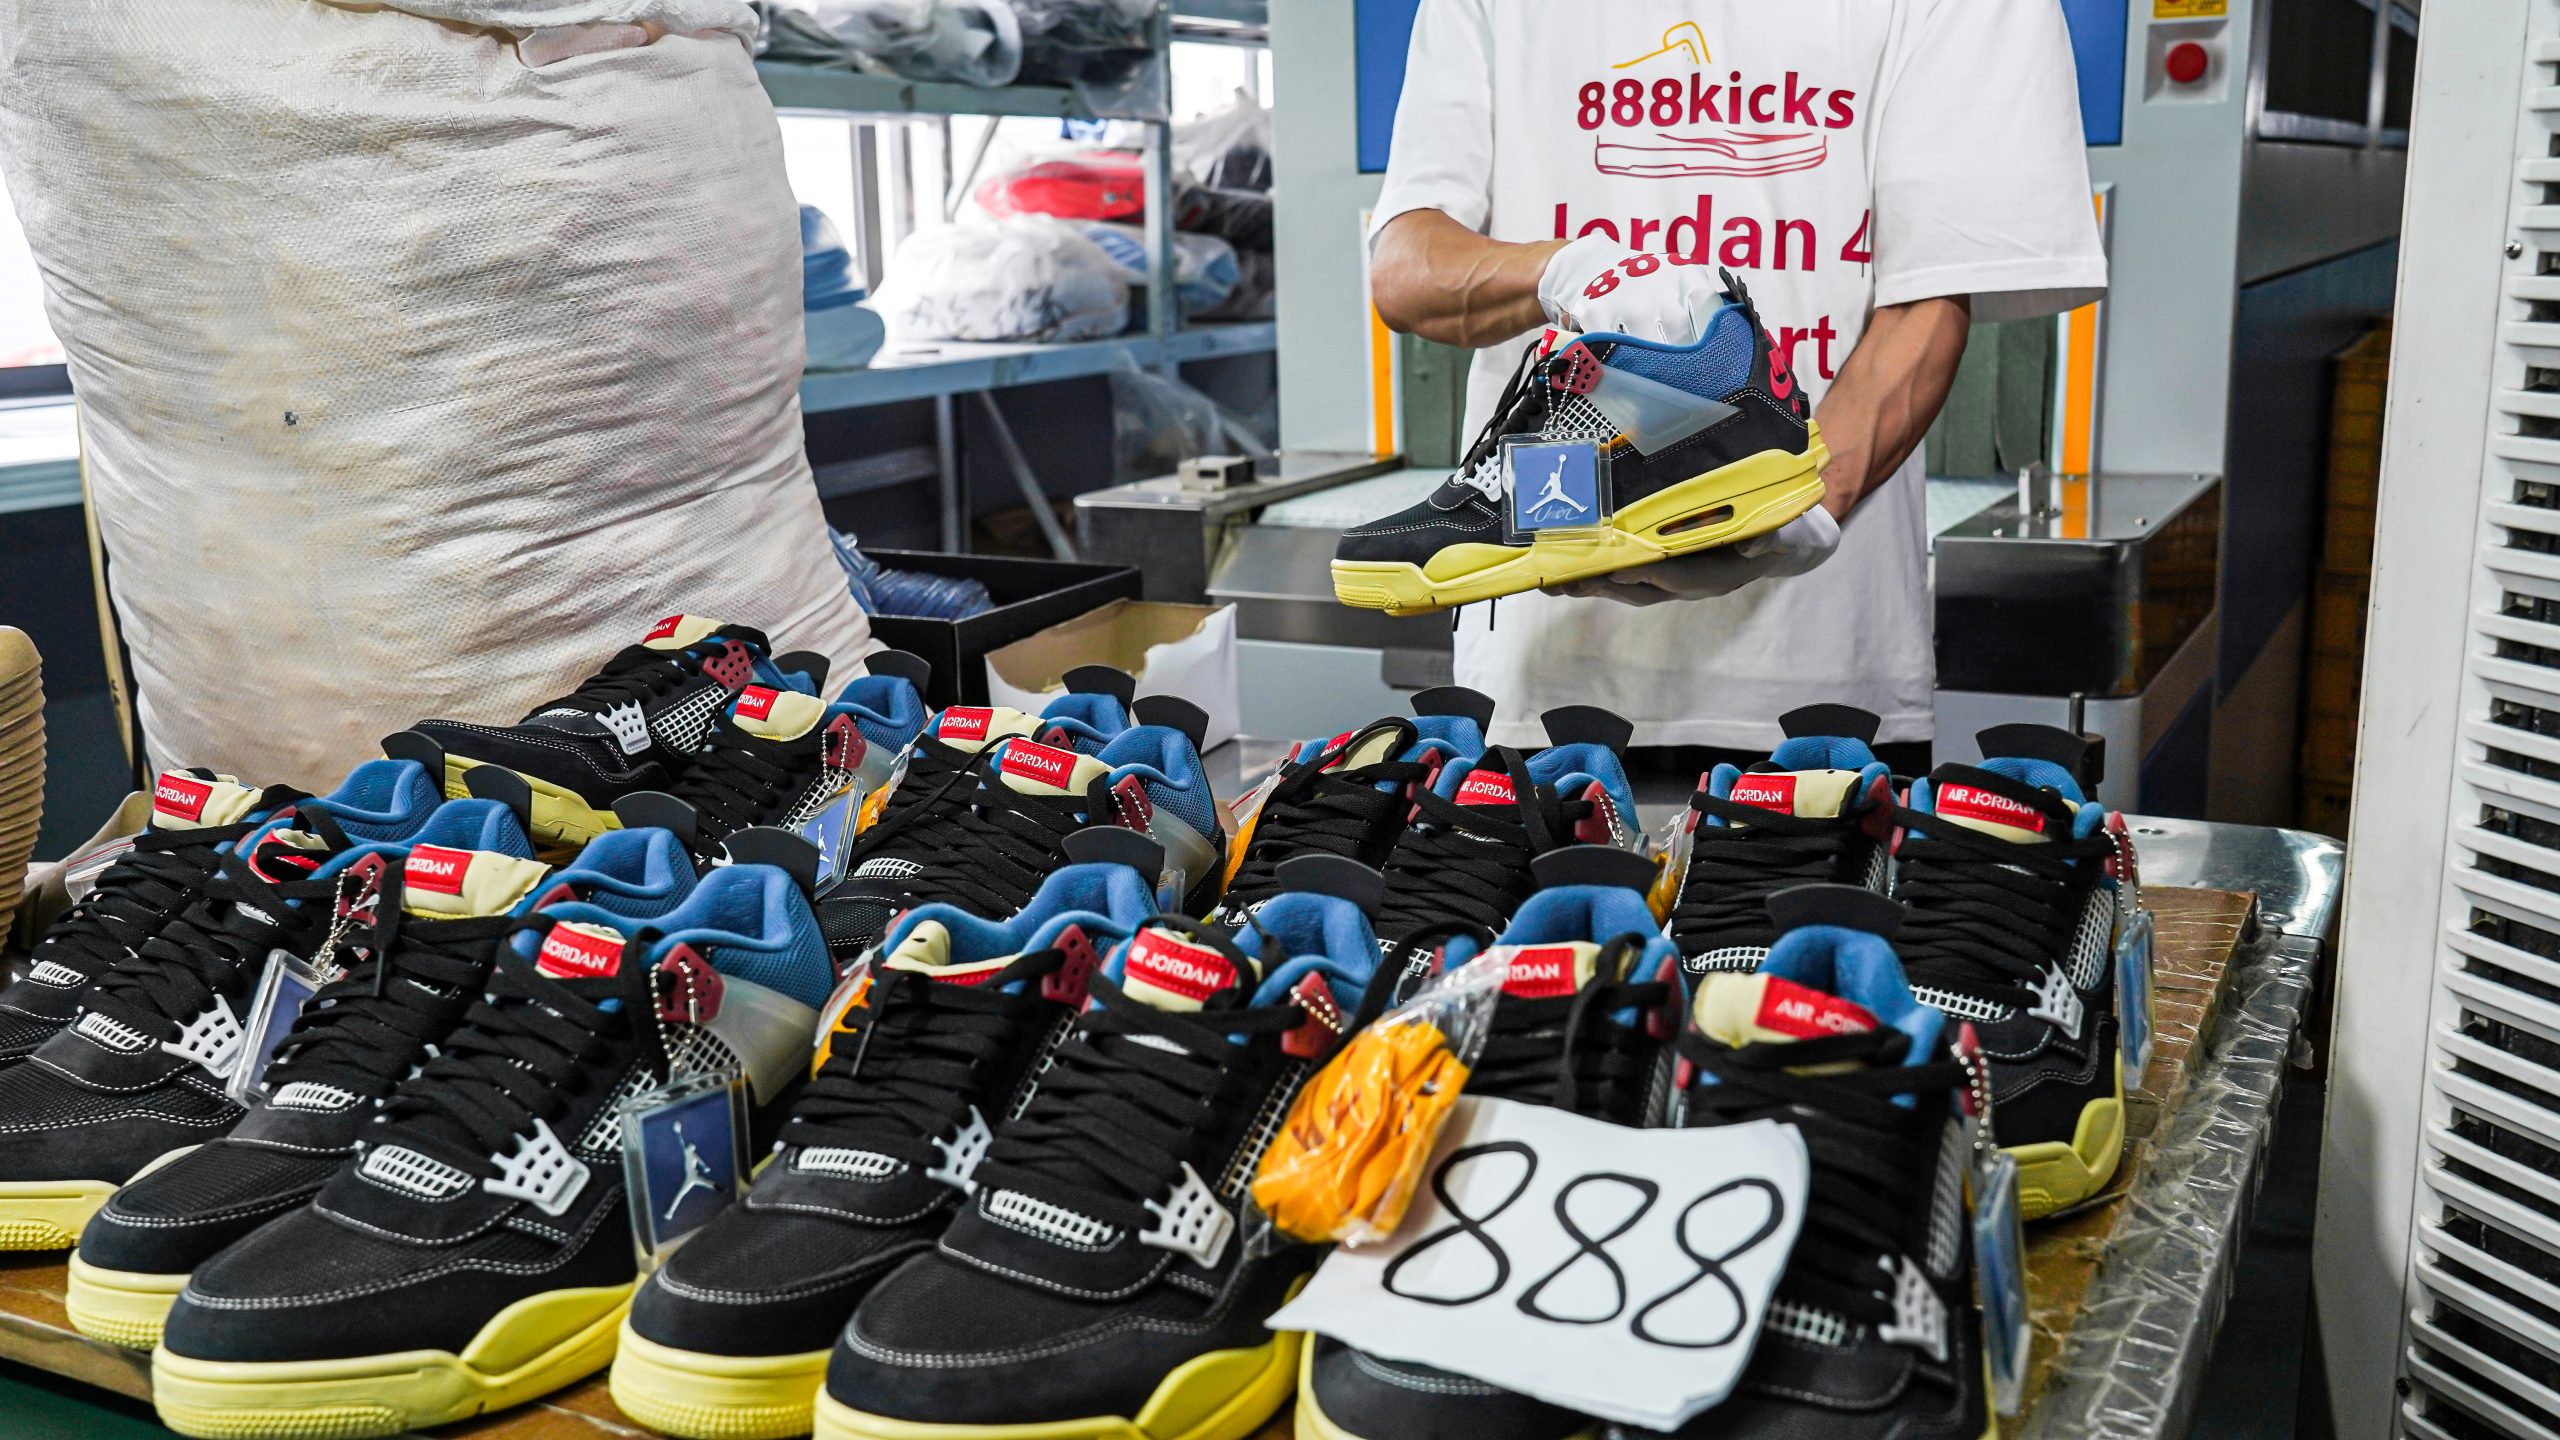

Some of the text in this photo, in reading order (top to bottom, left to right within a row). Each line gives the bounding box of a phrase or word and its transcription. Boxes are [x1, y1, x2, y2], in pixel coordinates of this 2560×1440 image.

[1577, 71, 1856, 131] 888kicks
[1840, 209, 1871, 277] 4
[943, 717, 982, 729] JORDAN
[1010, 751, 1063, 773] JORDAN
[1735, 788, 1783, 803] JORDAN
[1947, 788, 1969, 803] AIR
[1145, 952, 1220, 988] JORDAN
[1506, 962, 1561, 982] RDAN
[1775, 997, 1815, 1024] AIR
[1380, 1140, 1785, 1349] 888
